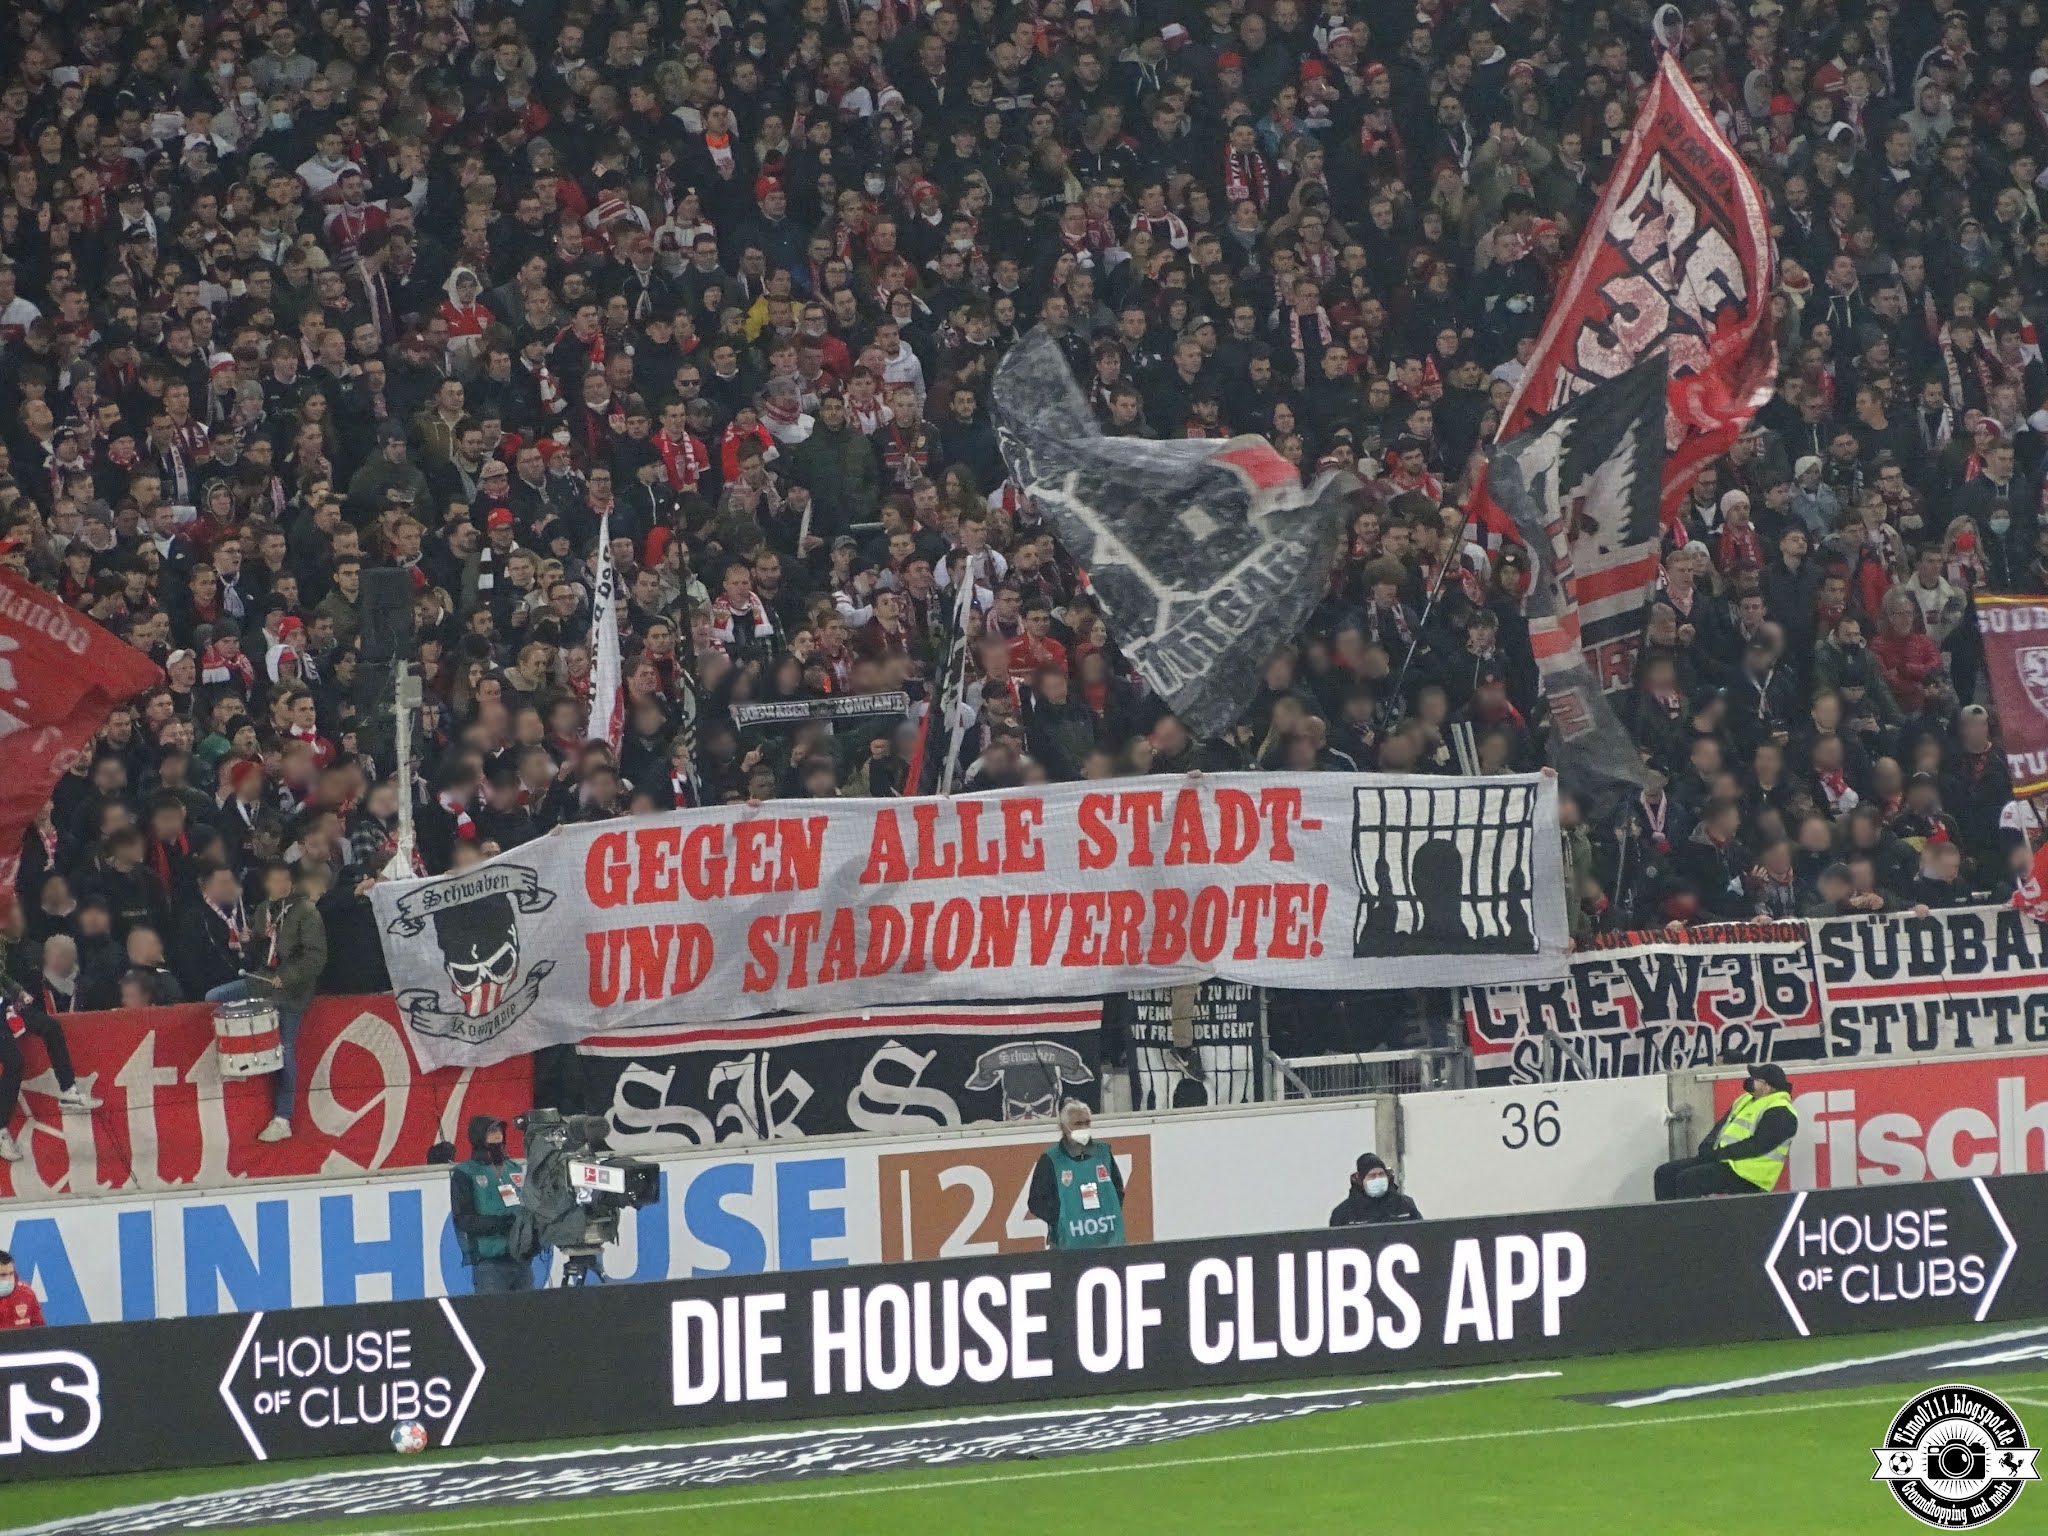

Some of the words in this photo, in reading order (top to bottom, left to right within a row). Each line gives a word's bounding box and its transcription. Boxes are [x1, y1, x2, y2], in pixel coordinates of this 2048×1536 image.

[585, 815, 829, 909] GEGEN
[860, 798, 1045, 885] ALLE
[1078, 788, 1322, 871] STADT-
[422, 874, 509, 910] Schwaben
[585, 923, 714, 1008] UND
[742, 883, 1329, 994] STADIONVERBOTE!
[1208, 985, 1222, 1001] ZU
[1225, 984, 1253, 1001] WEIT
[1222, 1022, 1254, 1038] GEHT
[1502, 1100, 1561, 1149] 36
[1789, 1076, 2048, 1191] fisch
[1069, 1215, 1117, 1237] HOST
[1799, 1208, 1948, 1257] HOUSE
[1798, 1267, 1833, 1291] OF
[1841, 1255, 1985, 1304] CLUBS
[672, 1293, 787, 1406] DIE
[812, 1272, 1053, 1395] HOUSE
[1076, 1263, 1166, 1373] OF
[1189, 1242, 1421, 1365] CLUBS
[1443, 1231, 1586, 1345] APP
[254, 1329, 412, 1379] HOUSE
[254, 1390, 291, 1415] OF
[299, 1377, 451, 1428] CLUBS
